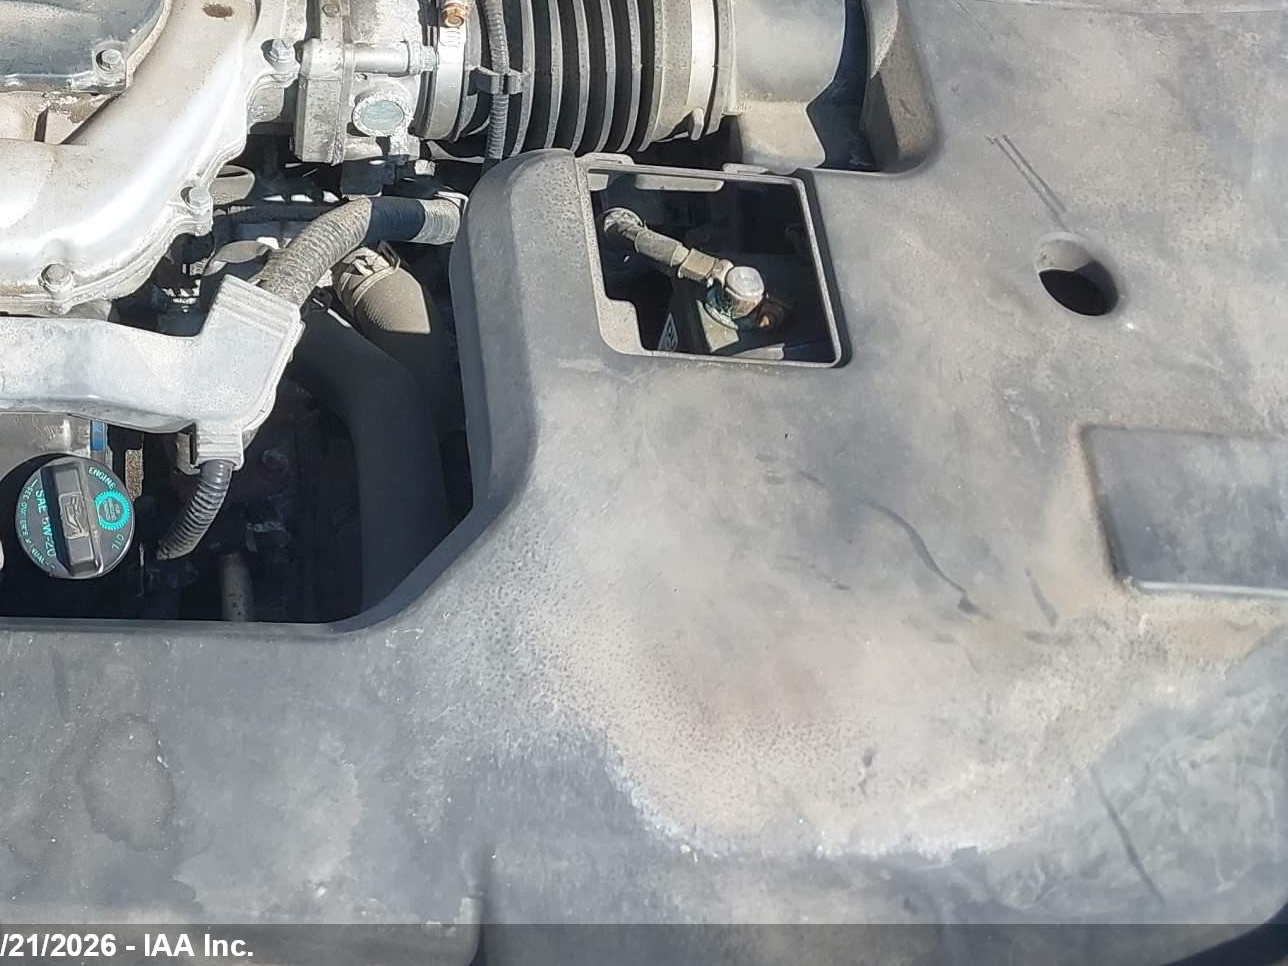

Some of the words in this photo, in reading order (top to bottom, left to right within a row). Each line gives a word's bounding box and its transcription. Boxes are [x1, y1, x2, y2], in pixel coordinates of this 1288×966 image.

[35, 490, 47, 513] SAE
[88, 466, 116, 489] ENGINE
[112, 533, 124, 550] OIL
